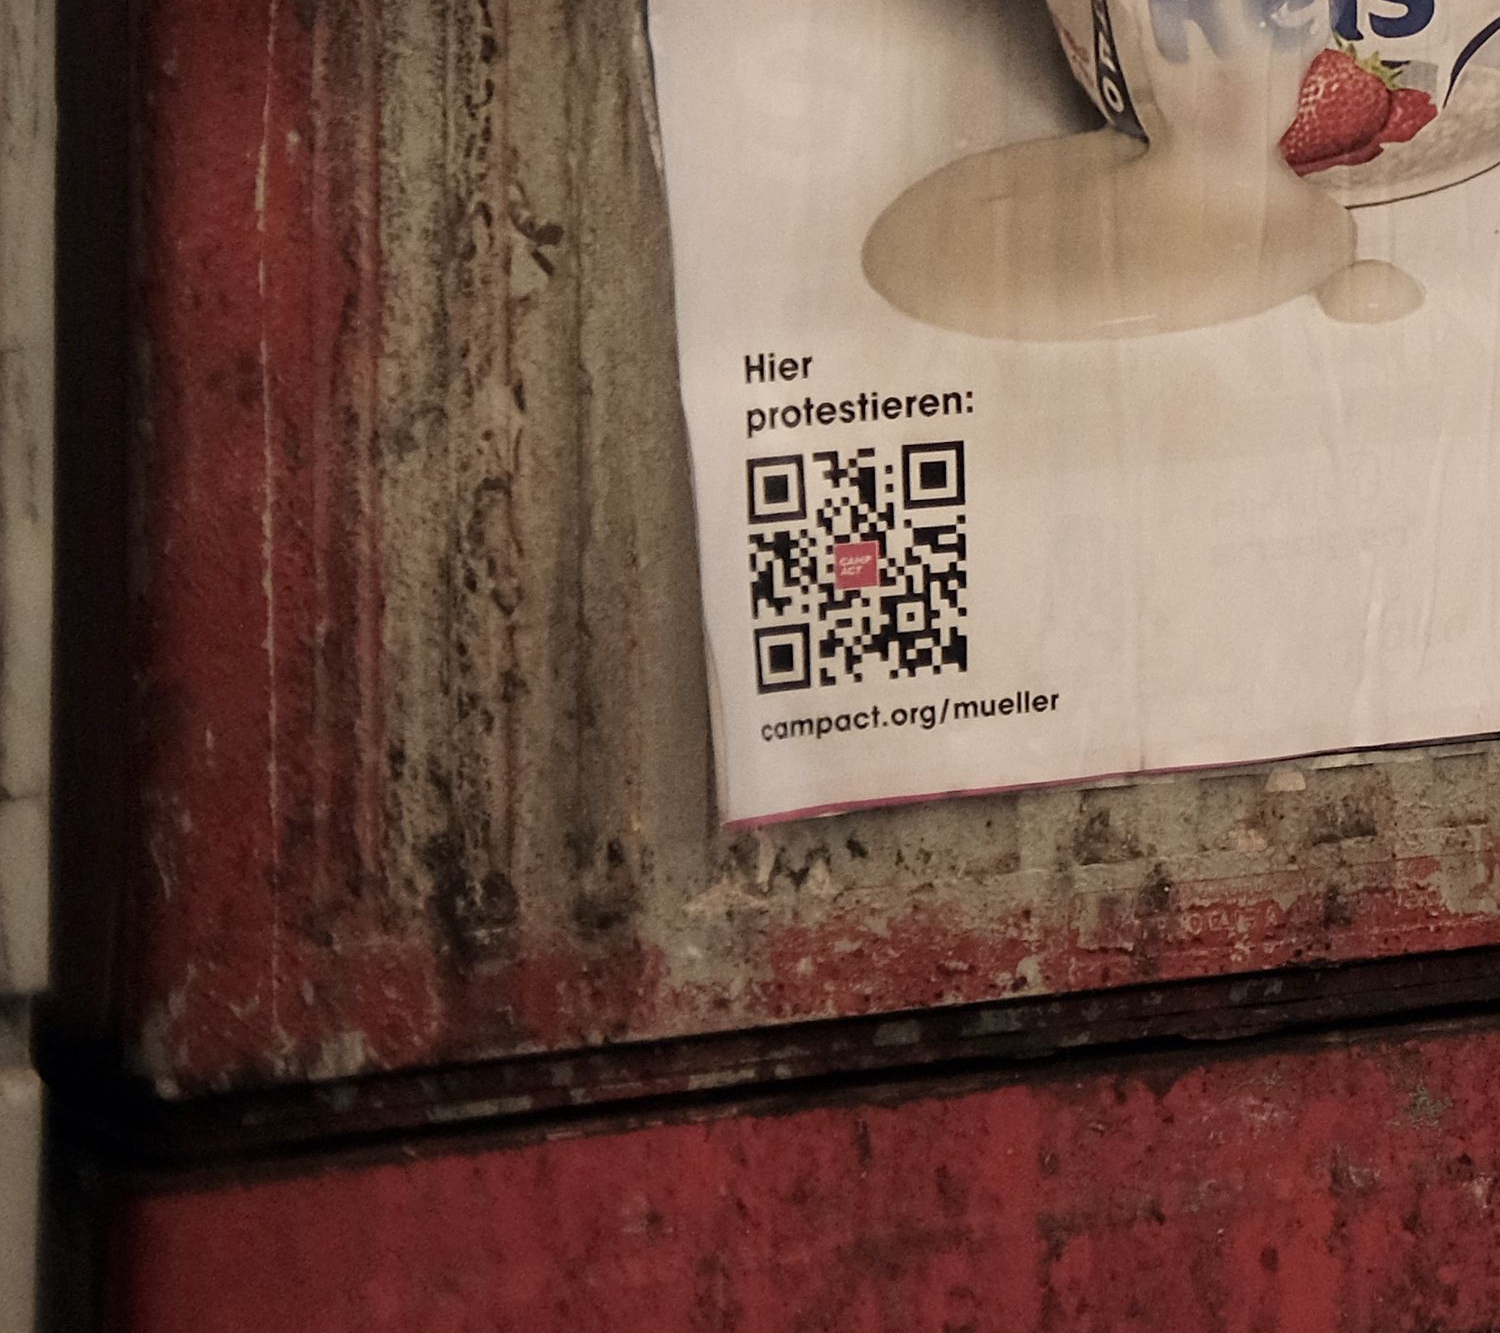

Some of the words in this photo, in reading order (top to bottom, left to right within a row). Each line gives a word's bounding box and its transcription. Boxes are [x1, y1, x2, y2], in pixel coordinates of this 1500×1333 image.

[743, 351, 814, 385] Hier
[745, 388, 975, 439] protestieren:
[759, 690, 1061, 742] campact.org/mueller
